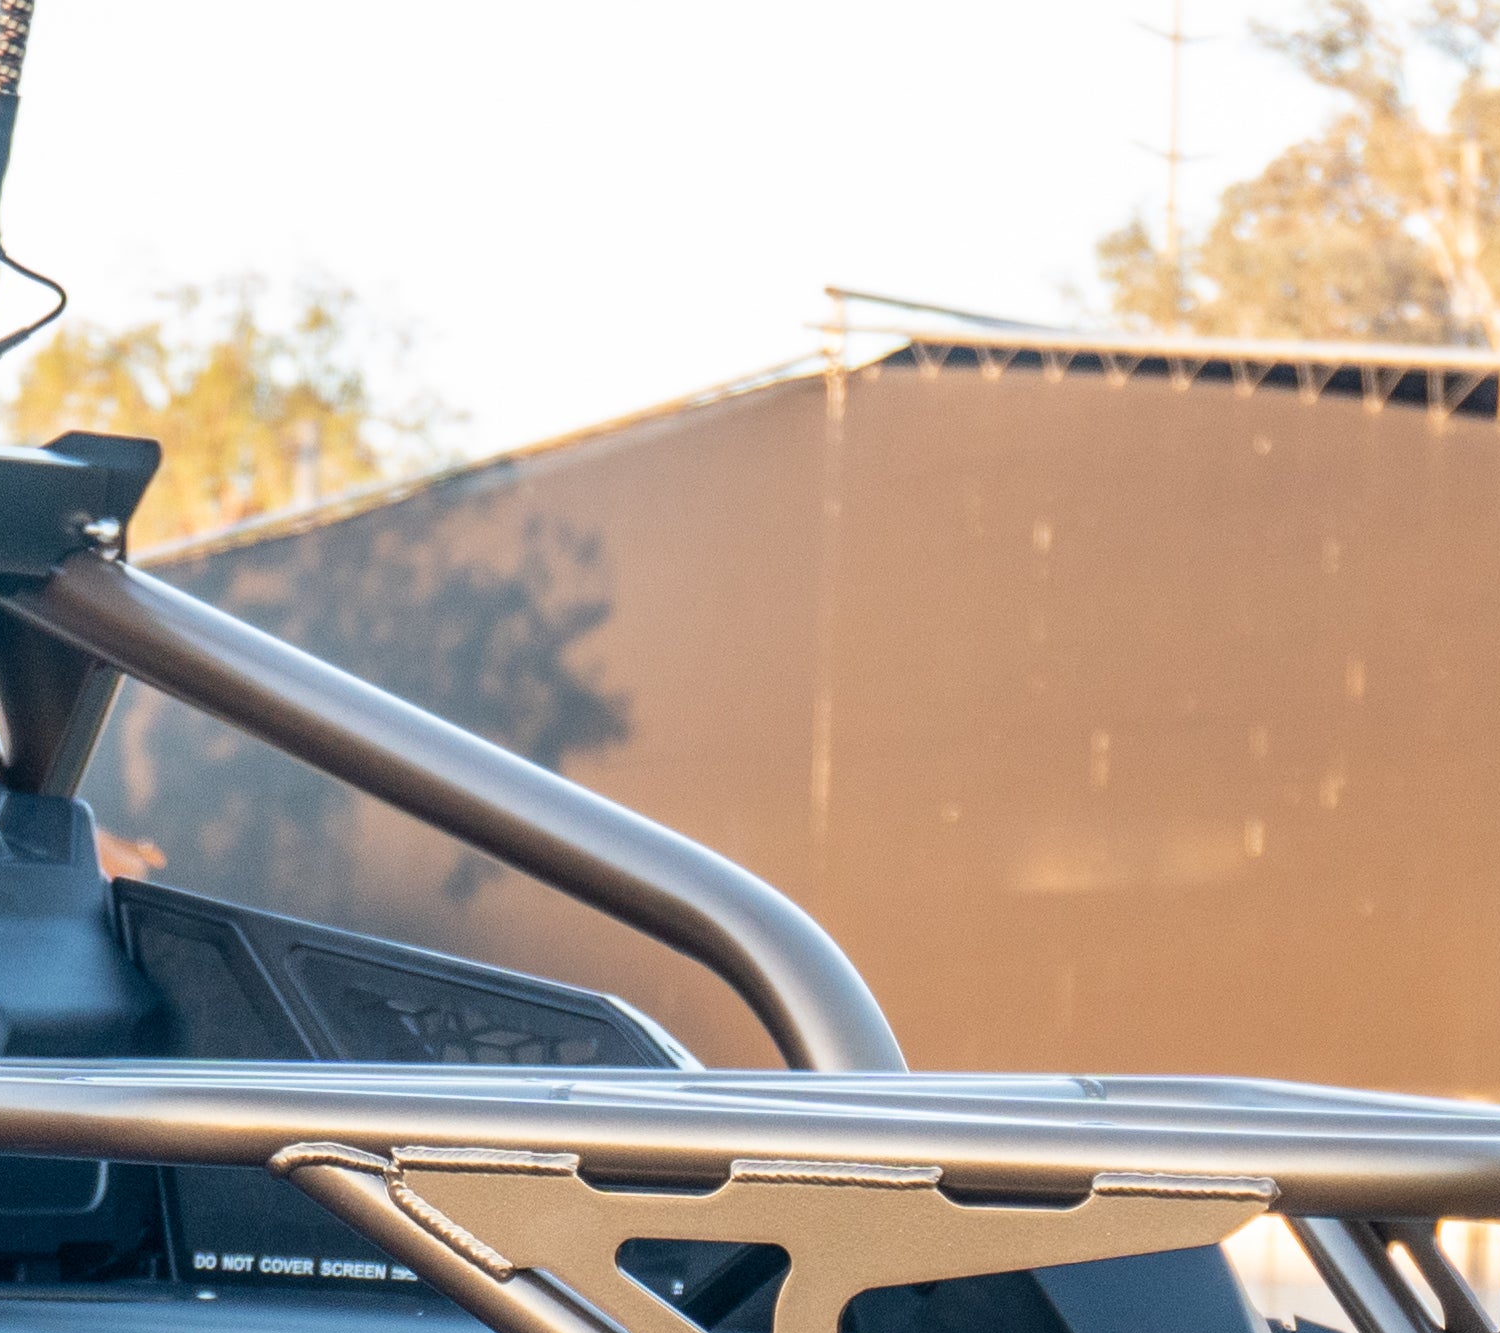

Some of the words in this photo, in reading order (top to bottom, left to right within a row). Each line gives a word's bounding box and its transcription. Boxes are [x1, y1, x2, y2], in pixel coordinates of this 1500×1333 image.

[193, 1252, 218, 1270] DO
[222, 1254, 255, 1272] NOT
[259, 1256, 315, 1276] COVER
[320, 1259, 388, 1279] SCREEN
